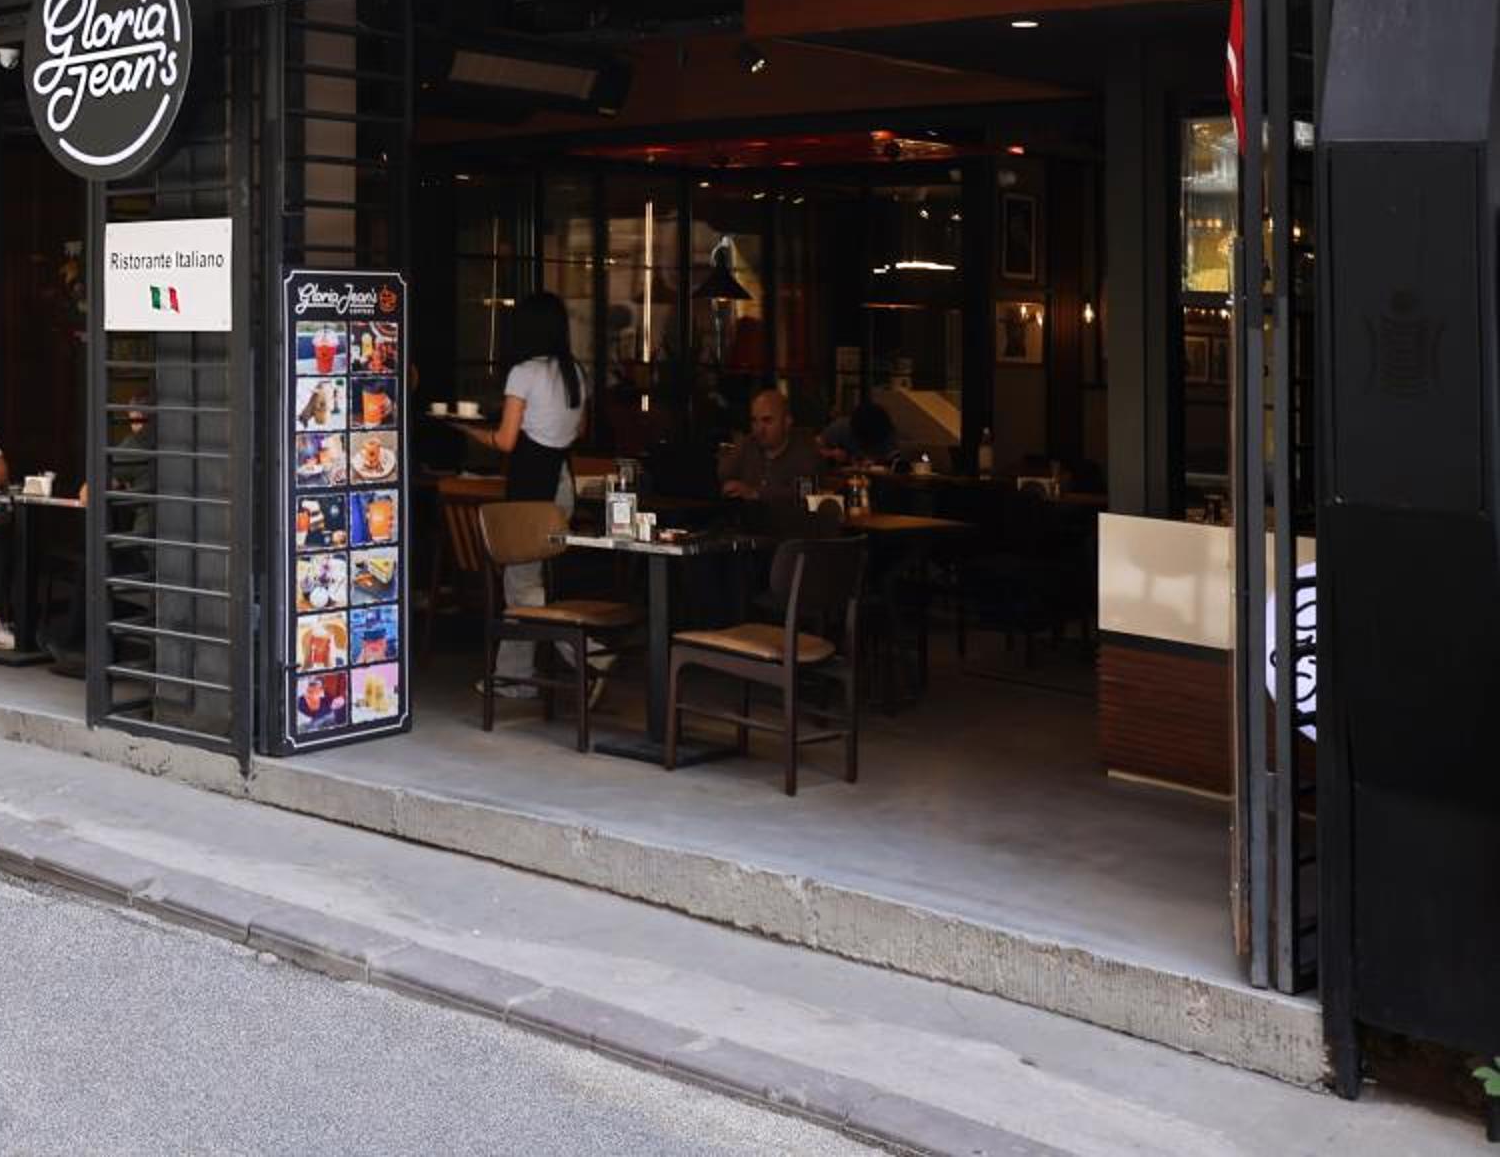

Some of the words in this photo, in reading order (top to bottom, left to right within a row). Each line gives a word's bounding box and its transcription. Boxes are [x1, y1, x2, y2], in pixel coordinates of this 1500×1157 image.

[47, 45, 178, 132] Jean's
[110, 252, 173, 270] Ristorante
[175, 250, 225, 268] Italiano
[294, 283, 339, 315] Gloria
[336, 283, 377, 315] Jean's
